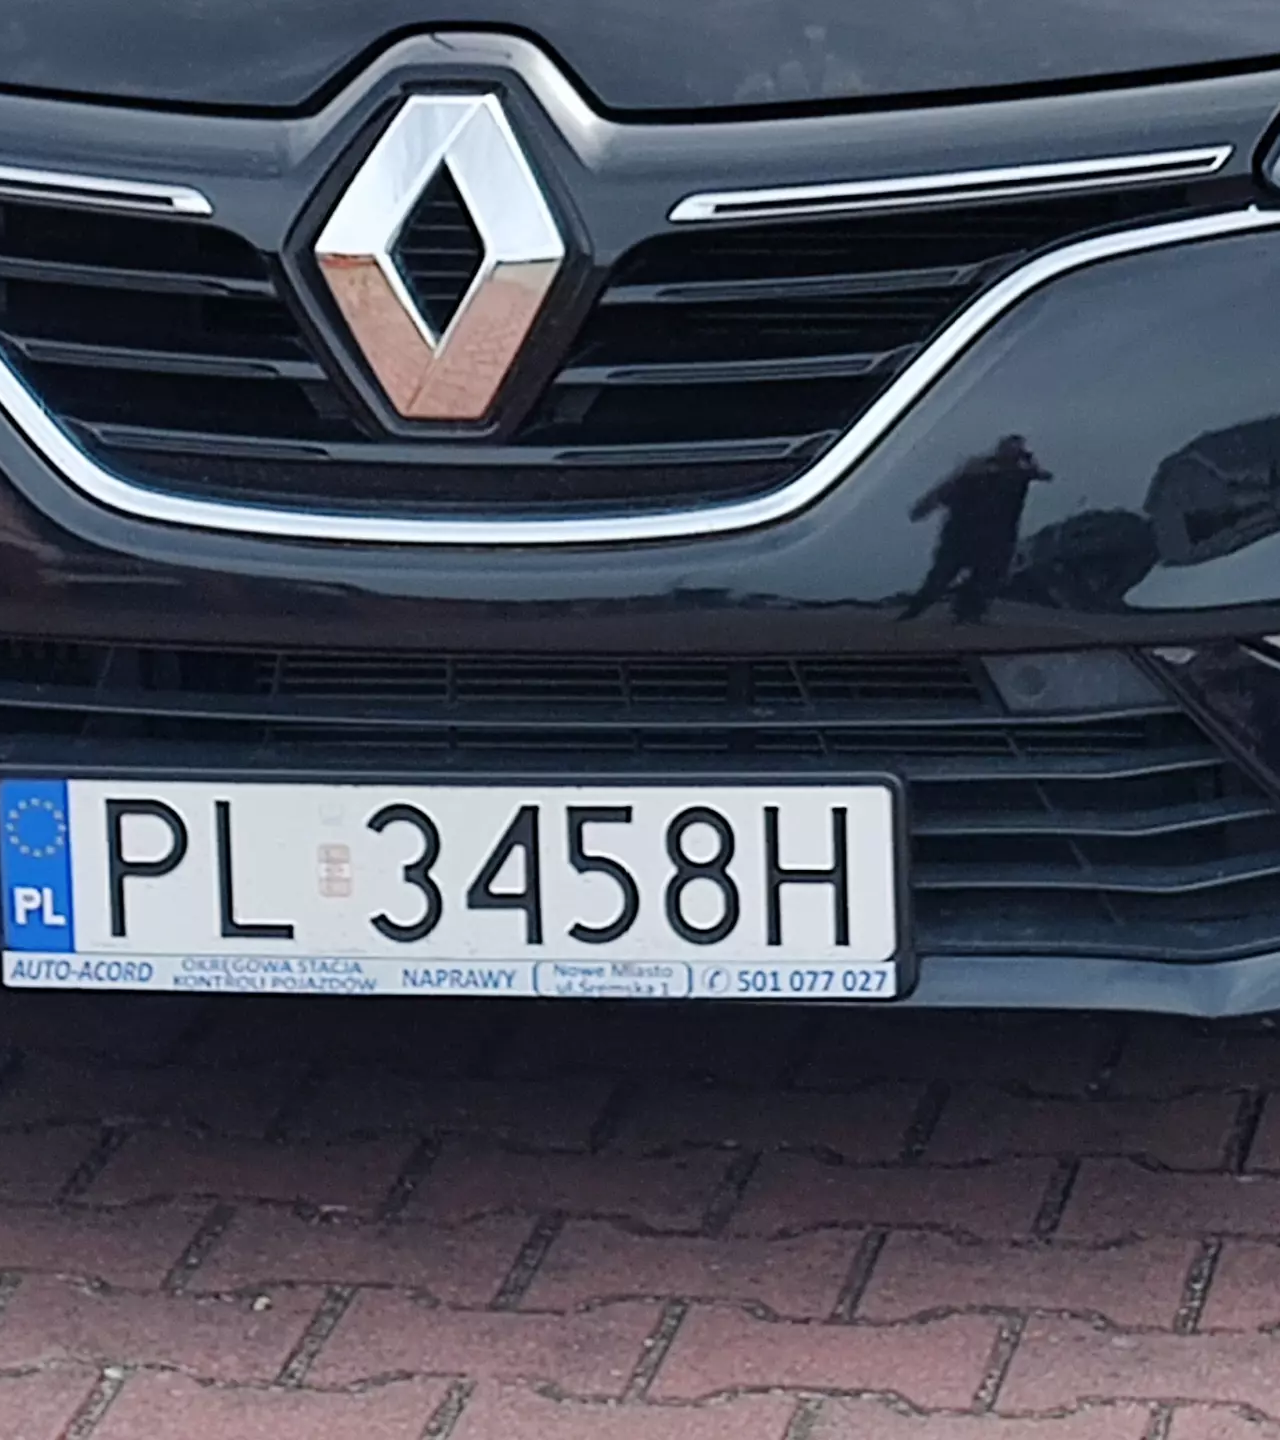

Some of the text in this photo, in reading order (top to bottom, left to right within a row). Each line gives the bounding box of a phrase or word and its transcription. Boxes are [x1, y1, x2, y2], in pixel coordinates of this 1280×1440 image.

[105, 798, 852, 946] PL 3458H
[14, 886, 67, 925] PL
[11, 959, 154, 982] AUTO-ACORD
[401, 968, 518, 989] NAPRAWY
[553, 962, 674, 978] Nowe Miasto
[736, 970, 888, 992] 501 077 027
